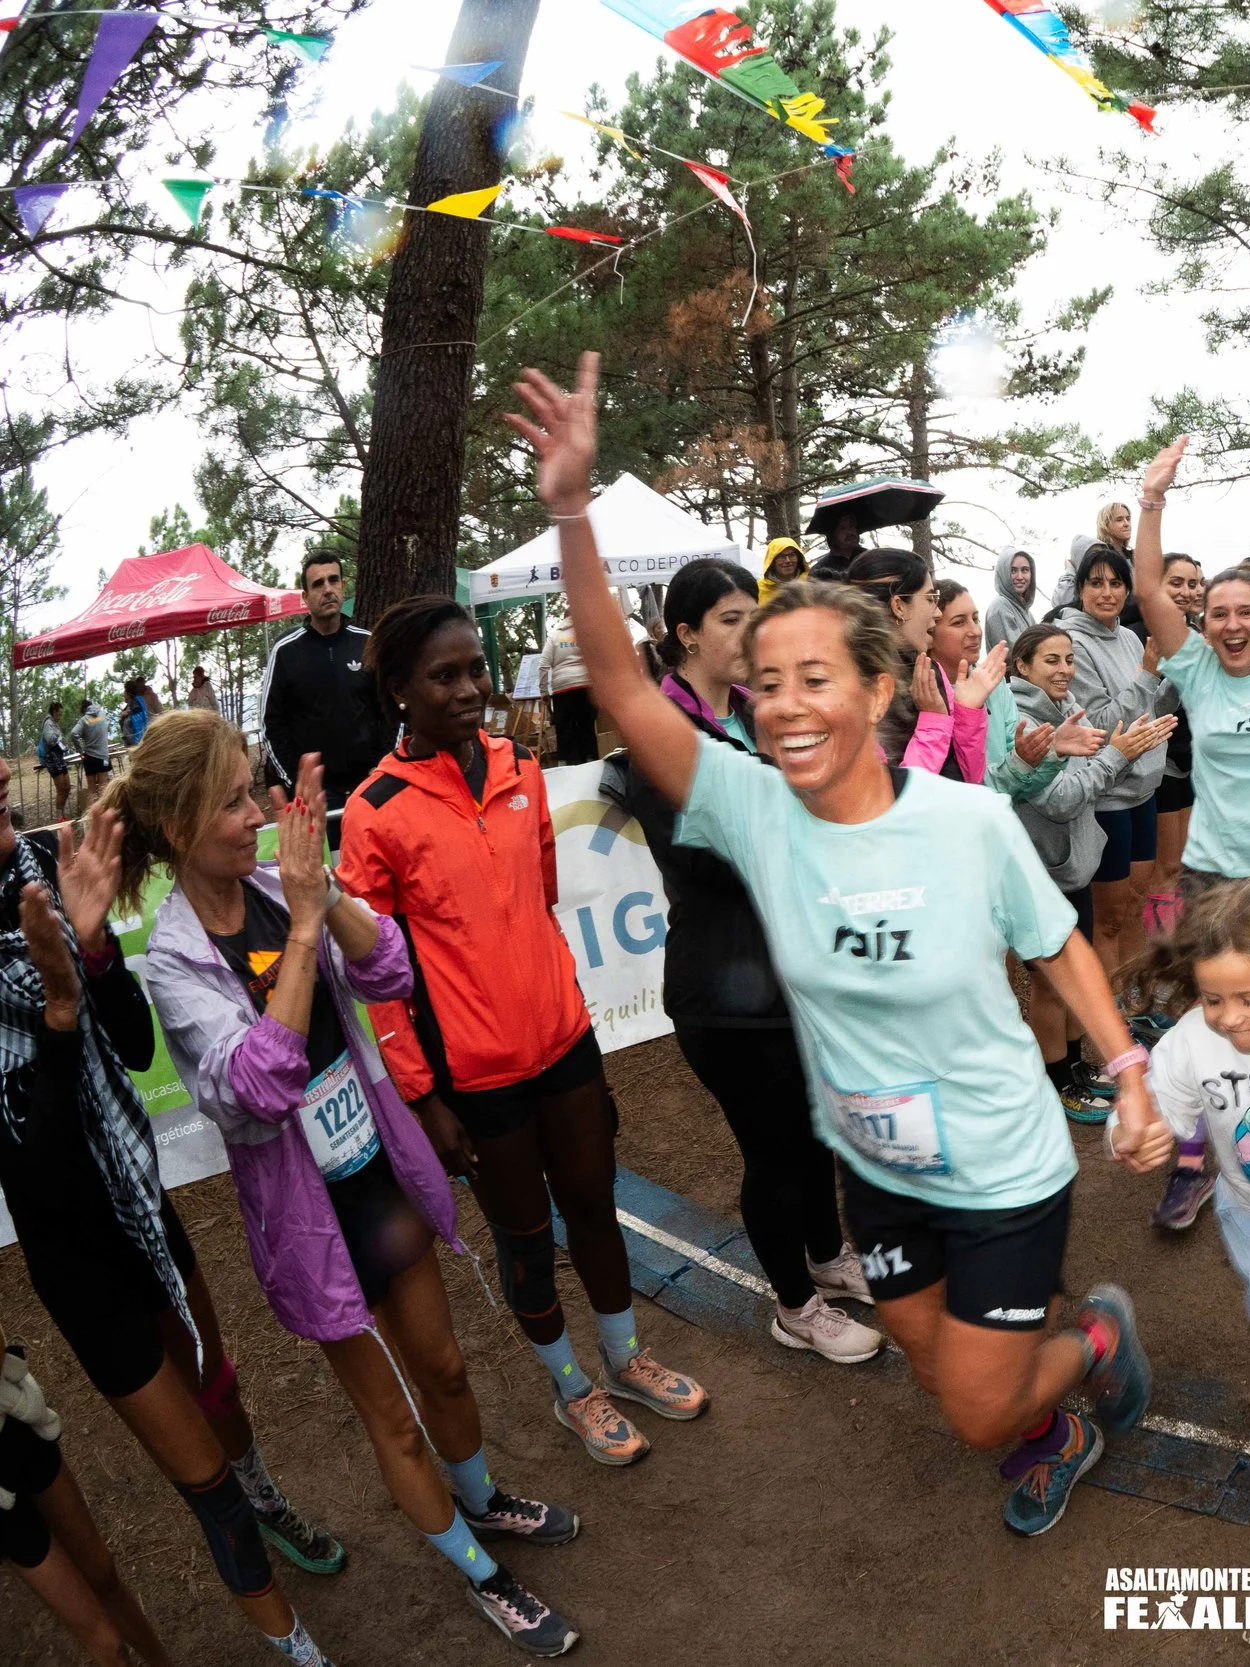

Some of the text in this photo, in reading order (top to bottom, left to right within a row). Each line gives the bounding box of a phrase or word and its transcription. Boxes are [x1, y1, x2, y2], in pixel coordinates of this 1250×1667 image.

[619, 559, 639, 573] CO
[832, 919, 916, 961] raíz
[586, 982, 664, 1034] Equili
[313, 1078, 364, 1139] 1222
[1005, 1306, 1046, 1322] TERREX
